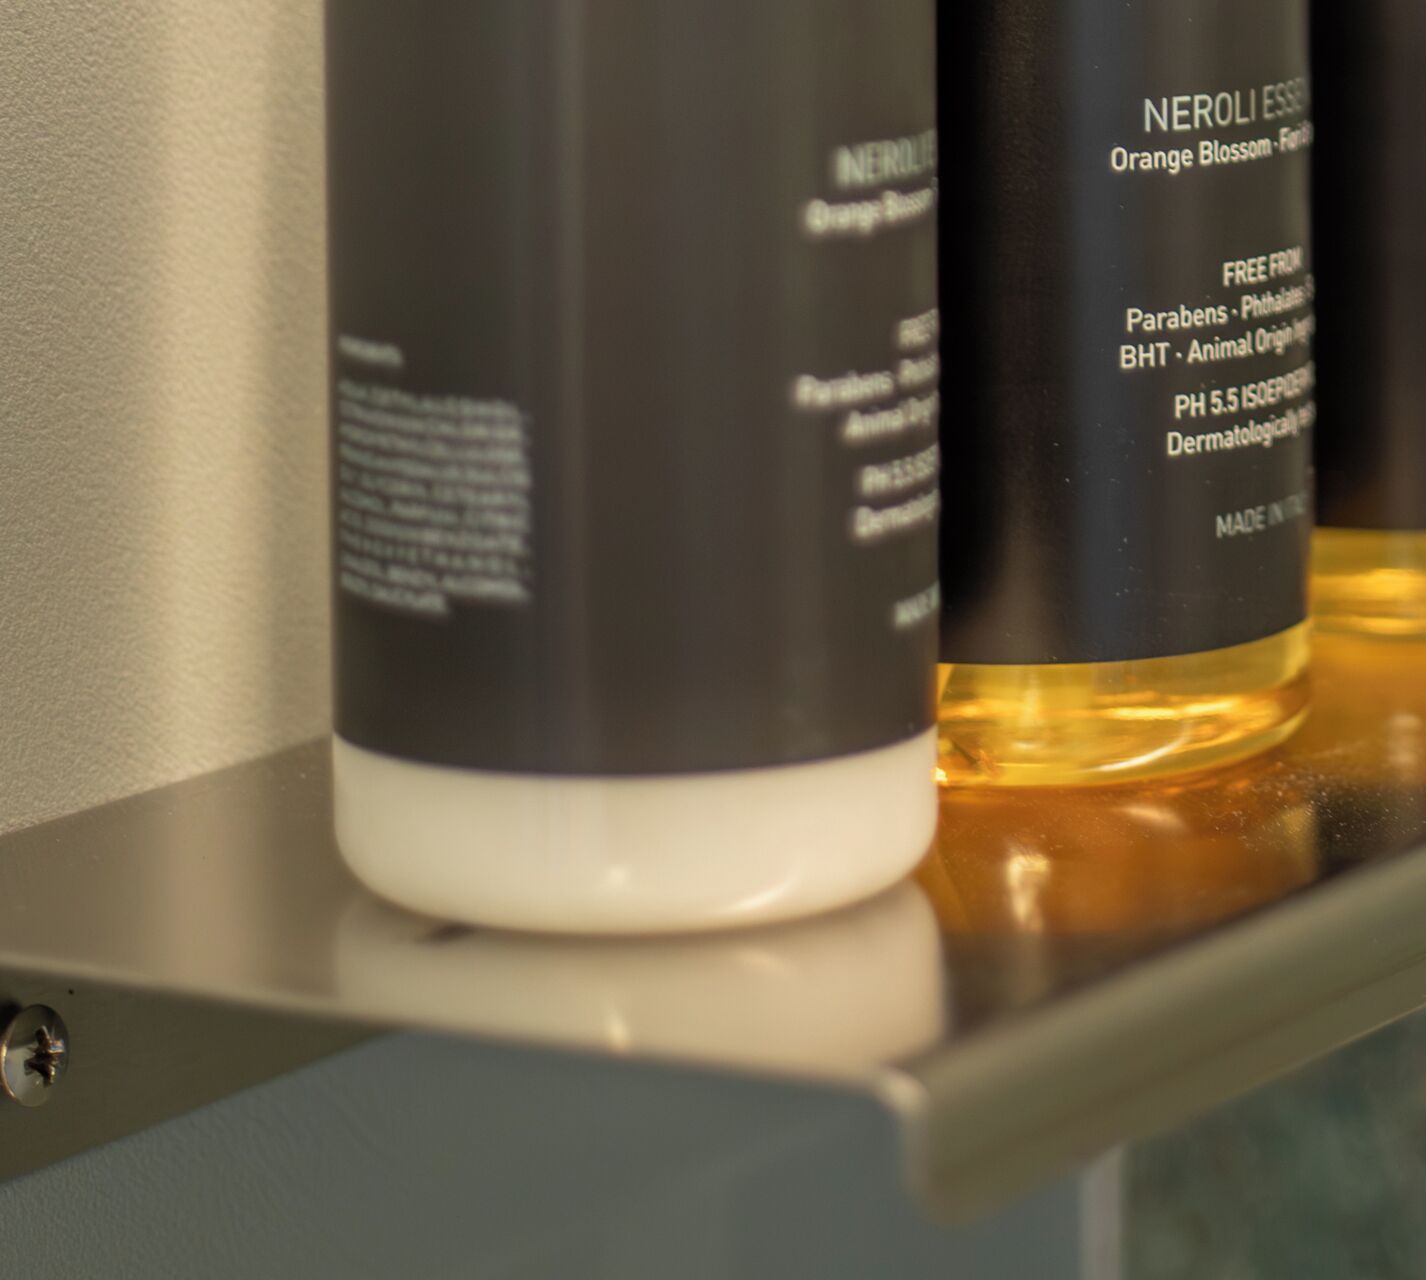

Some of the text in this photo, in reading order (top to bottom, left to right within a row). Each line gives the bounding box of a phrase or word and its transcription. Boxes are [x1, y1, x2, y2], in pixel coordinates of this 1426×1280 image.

[1144, 89, 1256, 132] NEROLI
[1111, 146, 1193, 175] Orange
[1199, 137, 1272, 166] Blossom
[1223, 256, 1267, 287] FREE
[1126, 304, 1228, 332] Parabens
[1120, 342, 1170, 369] BHT
[1187, 331, 1252, 363] Animal
[1255, 322, 1293, 355] Origin
[1175, 393, 1205, 419] PH
[1211, 388, 1239, 415] 5.5
[1216, 505, 1265, 538] MADE
